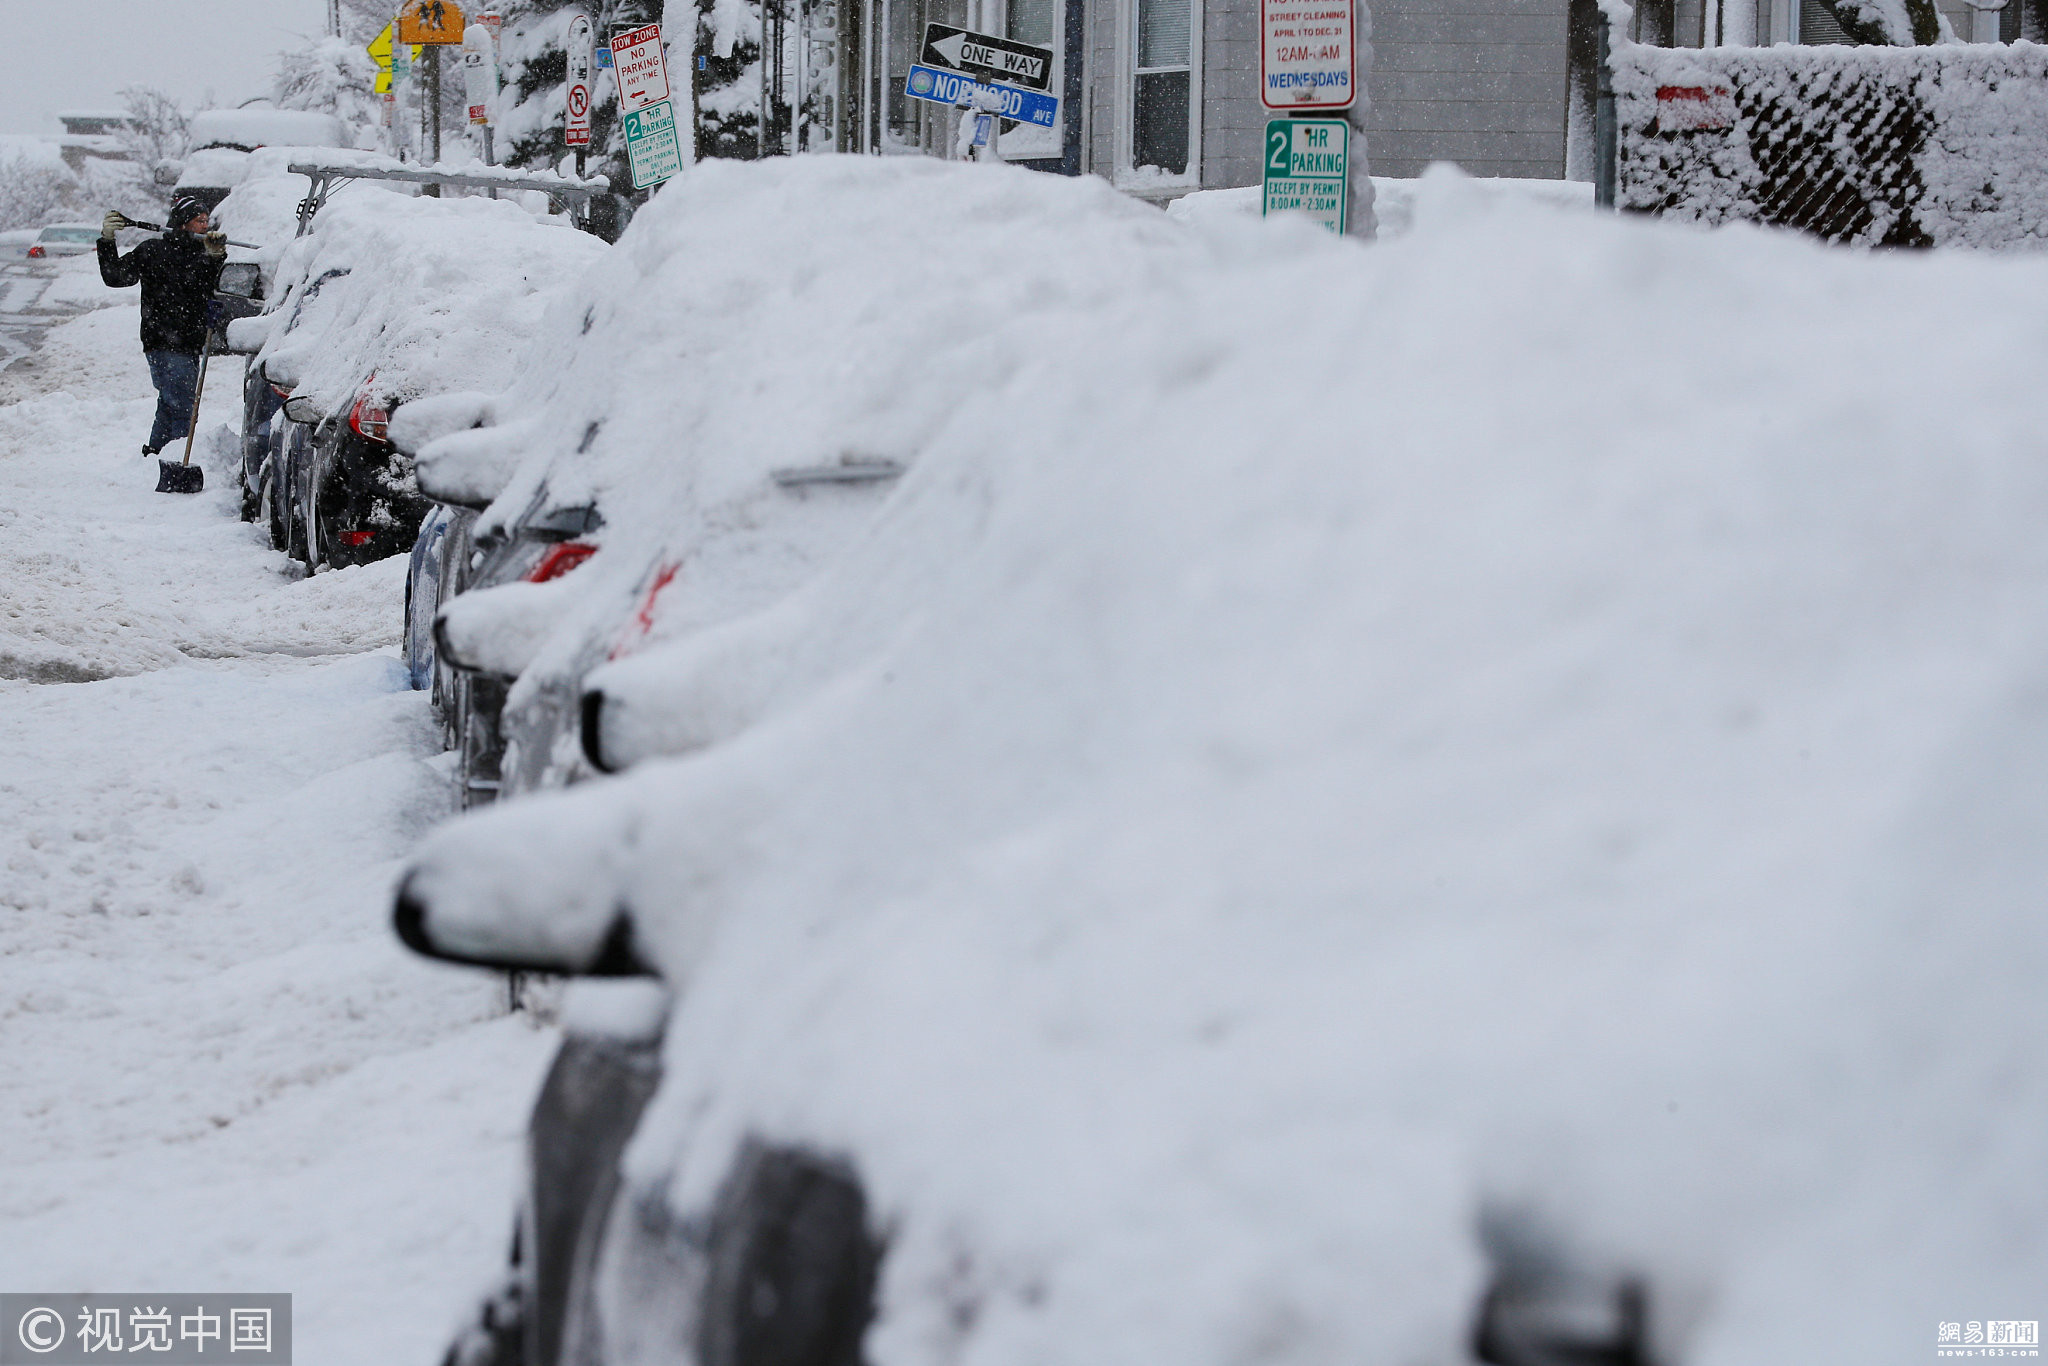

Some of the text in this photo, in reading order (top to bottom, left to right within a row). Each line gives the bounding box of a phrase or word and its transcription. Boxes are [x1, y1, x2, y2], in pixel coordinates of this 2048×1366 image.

[1270, 10, 1346, 22] STREET CLEANING
[613, 26, 658, 50] TOW ZONE
[1274, 29, 1295, 37] APRIL
[1303, 28, 1314, 36] TO
[630, 47, 646, 60] NO
[960, 43, 1041, 75] ONE WAY
[1276, 44, 1340, 62] 12AM-AM
[621, 55, 659, 77] PARKING
[627, 69, 658, 86] ANY TIME
[1268, 70, 1348, 89] WEDNESDAYS
[649, 107, 661, 120] HR
[1033, 109, 1053, 124] AVE
[627, 118, 640, 138] 2
[641, 116, 672, 134] PARKING
[631, 139, 649, 151] EXCEPT
[657, 130, 674, 141] PERMIT
[1308, 128, 1329, 148] HR
[1269, 131, 1288, 169] 2
[651, 161, 663, 170] ONLY
[1291, 152, 1343, 173] PARKING
[1268, 181, 1340, 196] EXCEPT BY PERMIT
[1270, 197, 1301, 210] 8:00AM
[1307, 198, 1337, 211] 2:30AM
